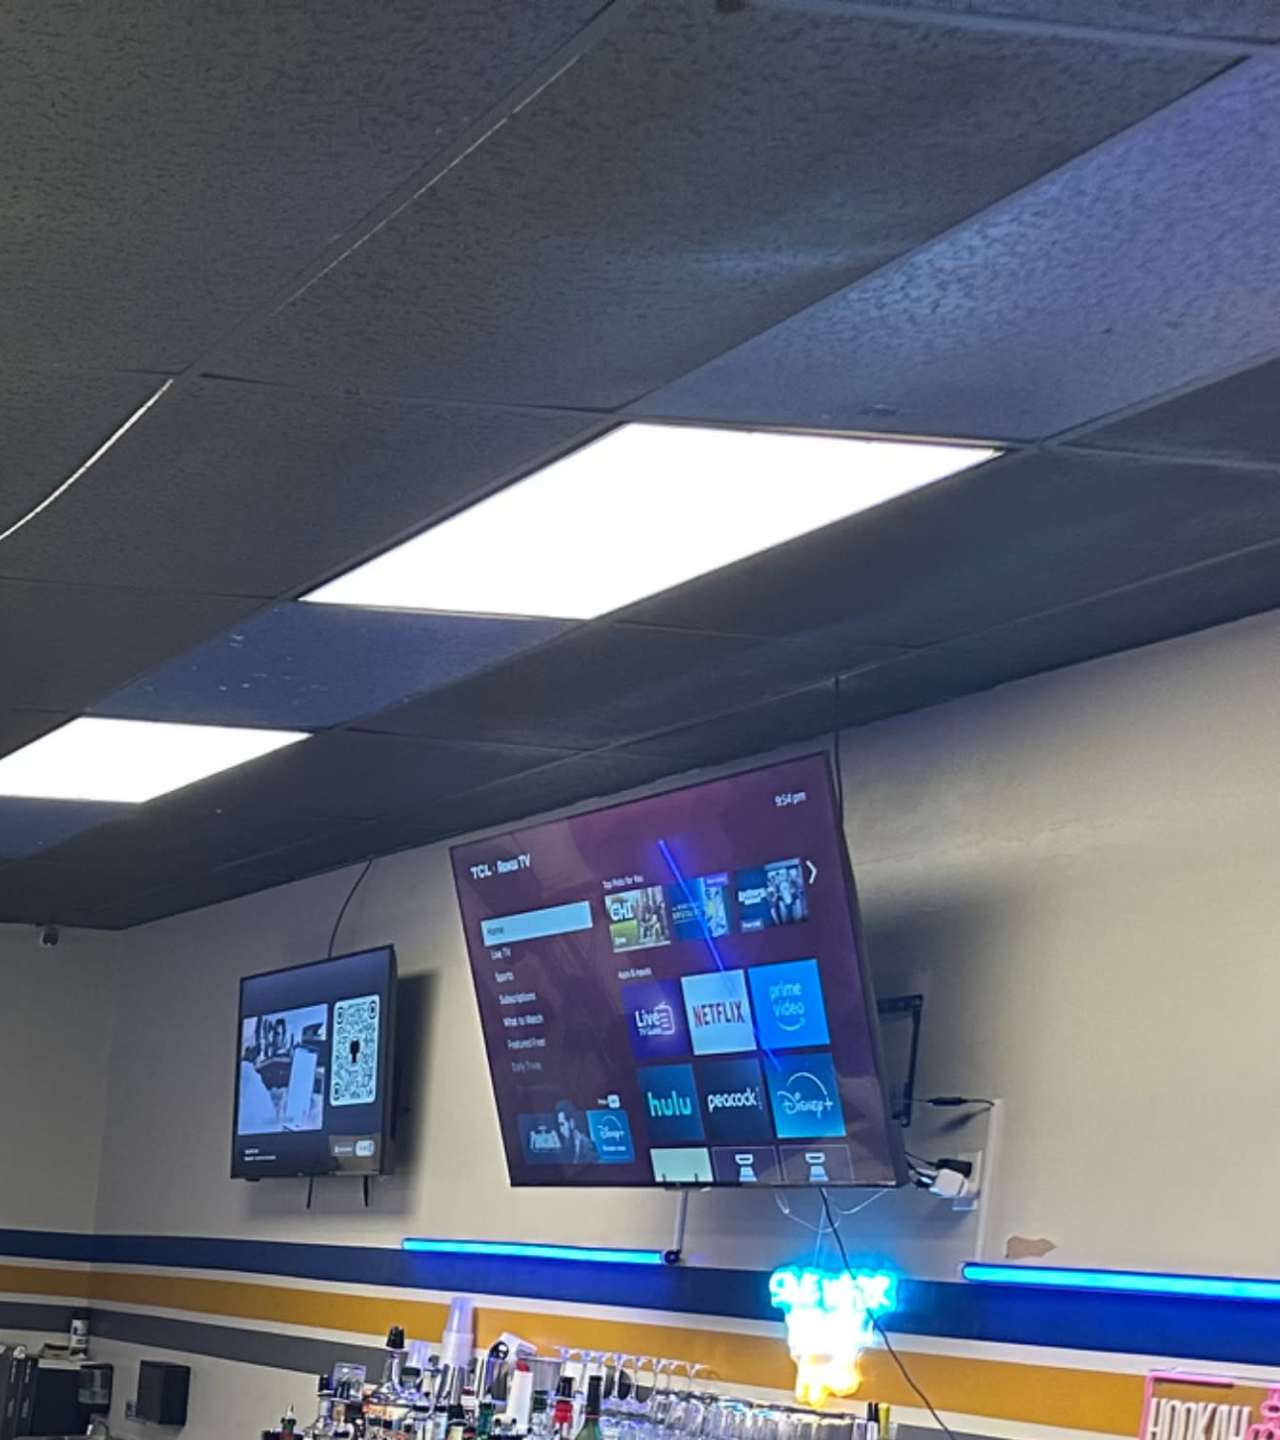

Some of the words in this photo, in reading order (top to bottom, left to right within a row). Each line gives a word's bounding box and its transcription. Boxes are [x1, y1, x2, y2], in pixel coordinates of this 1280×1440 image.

[471, 864, 492, 879] TCL
[497, 858, 518, 874] Roku
[518, 853, 531, 868] TV
[769, 980, 802, 1000] prime
[635, 1009, 660, 1027] Live
[692, 1000, 745, 1028] NETFLIX
[772, 1000, 805, 1017] video
[647, 1090, 692, 1117] hulu
[707, 1087, 758, 1113] peacock
